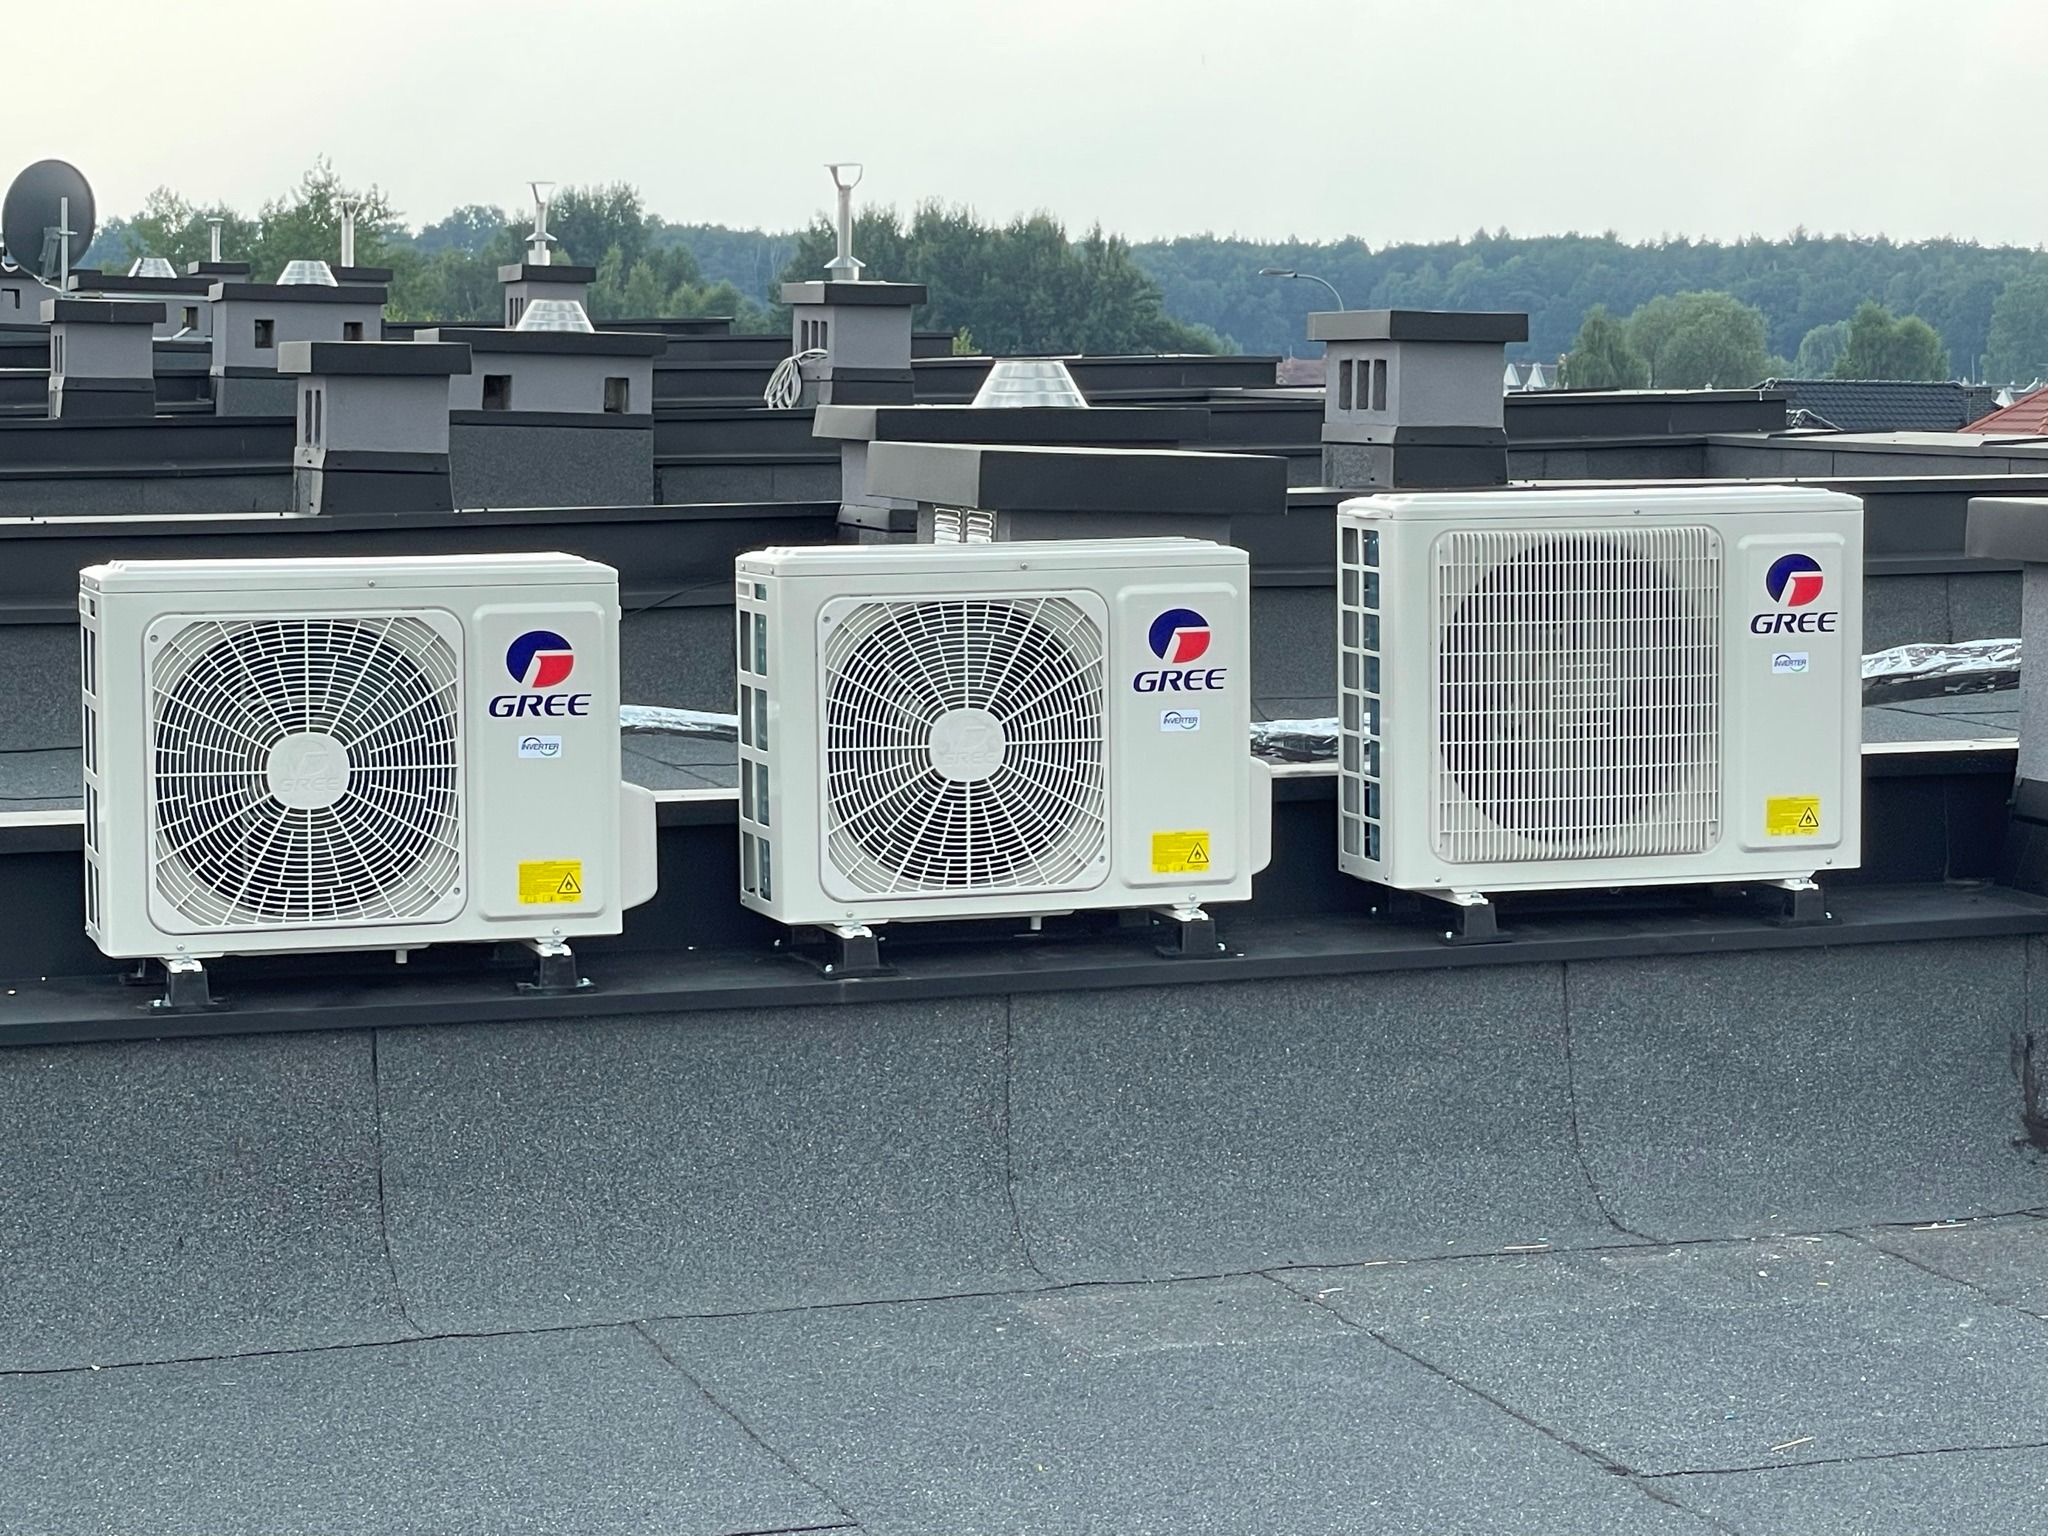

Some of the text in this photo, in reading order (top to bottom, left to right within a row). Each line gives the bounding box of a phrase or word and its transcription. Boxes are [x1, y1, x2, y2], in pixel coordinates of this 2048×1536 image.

[1750, 612, 1837, 633] GREE
[1773, 659, 1807, 667] INVERTER
[1133, 669, 1227, 692] GREE
[489, 694, 591, 717] GREE
[1163, 716, 1198, 725] INVERTER
[521, 743, 560, 751] INVERTER
[943, 751, 996, 766] GREE
[280, 777, 339, 792] GREE
